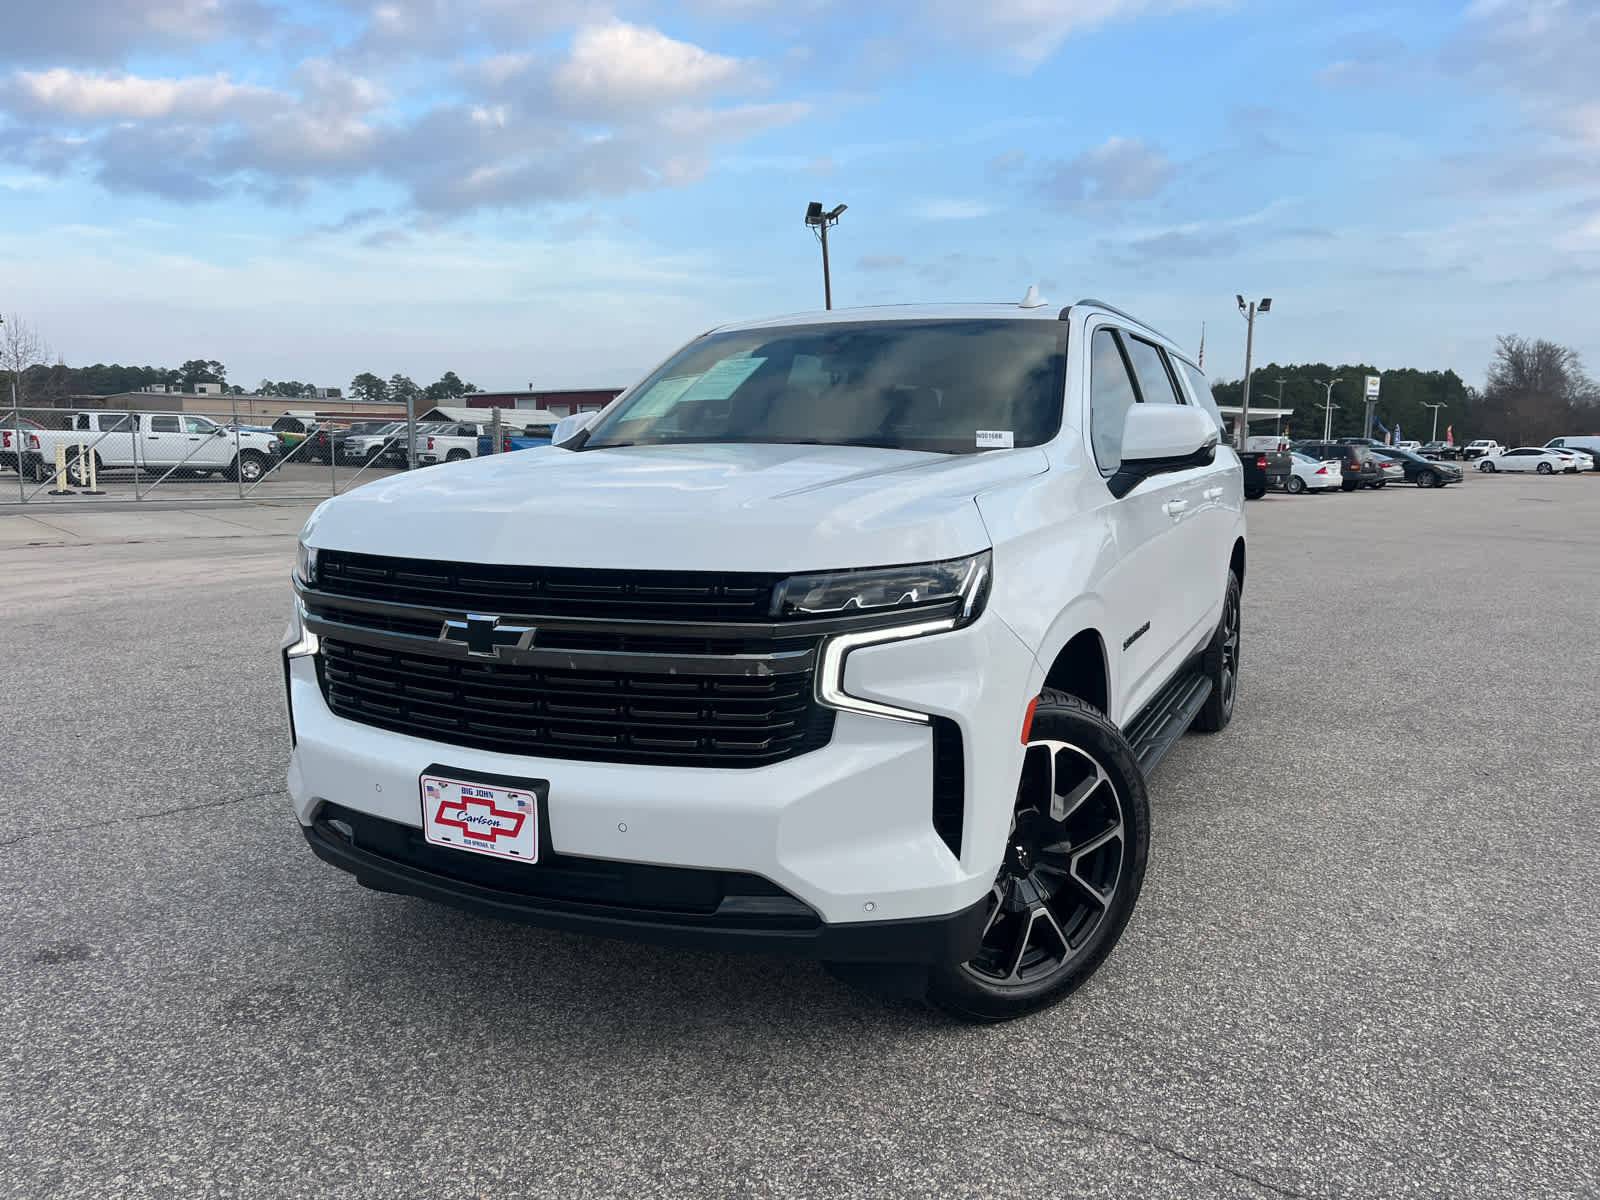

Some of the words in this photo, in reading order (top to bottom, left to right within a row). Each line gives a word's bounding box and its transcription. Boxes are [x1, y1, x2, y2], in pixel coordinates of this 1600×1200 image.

[461, 787, 473, 796] BIG
[475, 789, 494, 799] JOHN
[456, 810, 501, 827] Carlson
